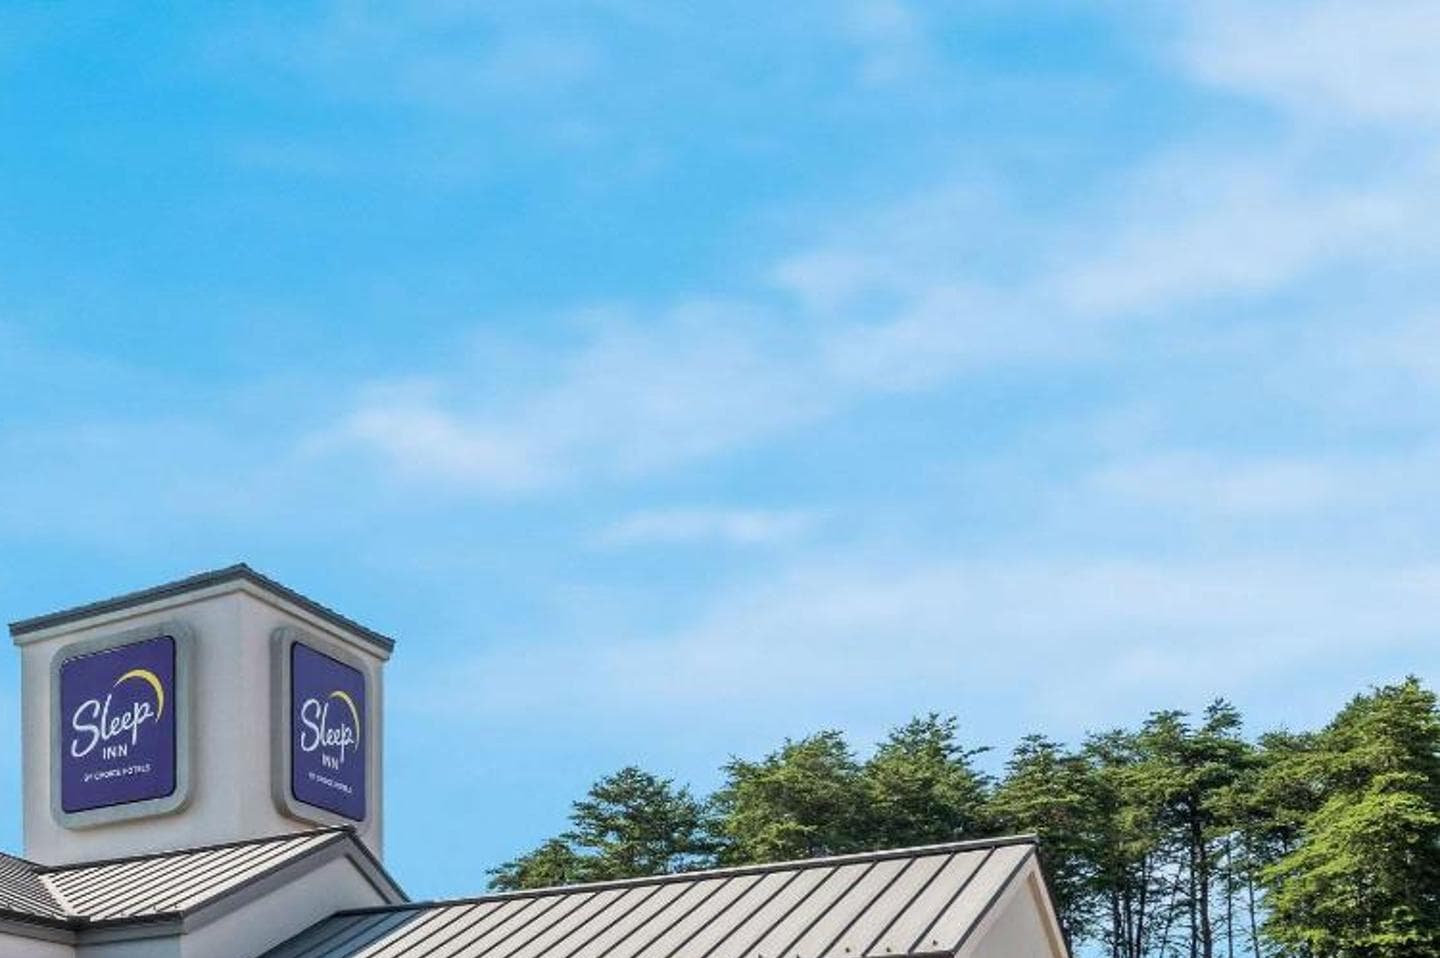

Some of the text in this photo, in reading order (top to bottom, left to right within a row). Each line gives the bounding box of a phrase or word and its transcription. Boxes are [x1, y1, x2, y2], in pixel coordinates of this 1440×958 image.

[70, 693, 154, 758] Sleep
[103, 743, 128, 760] INN
[300, 698, 354, 764] Sleep
